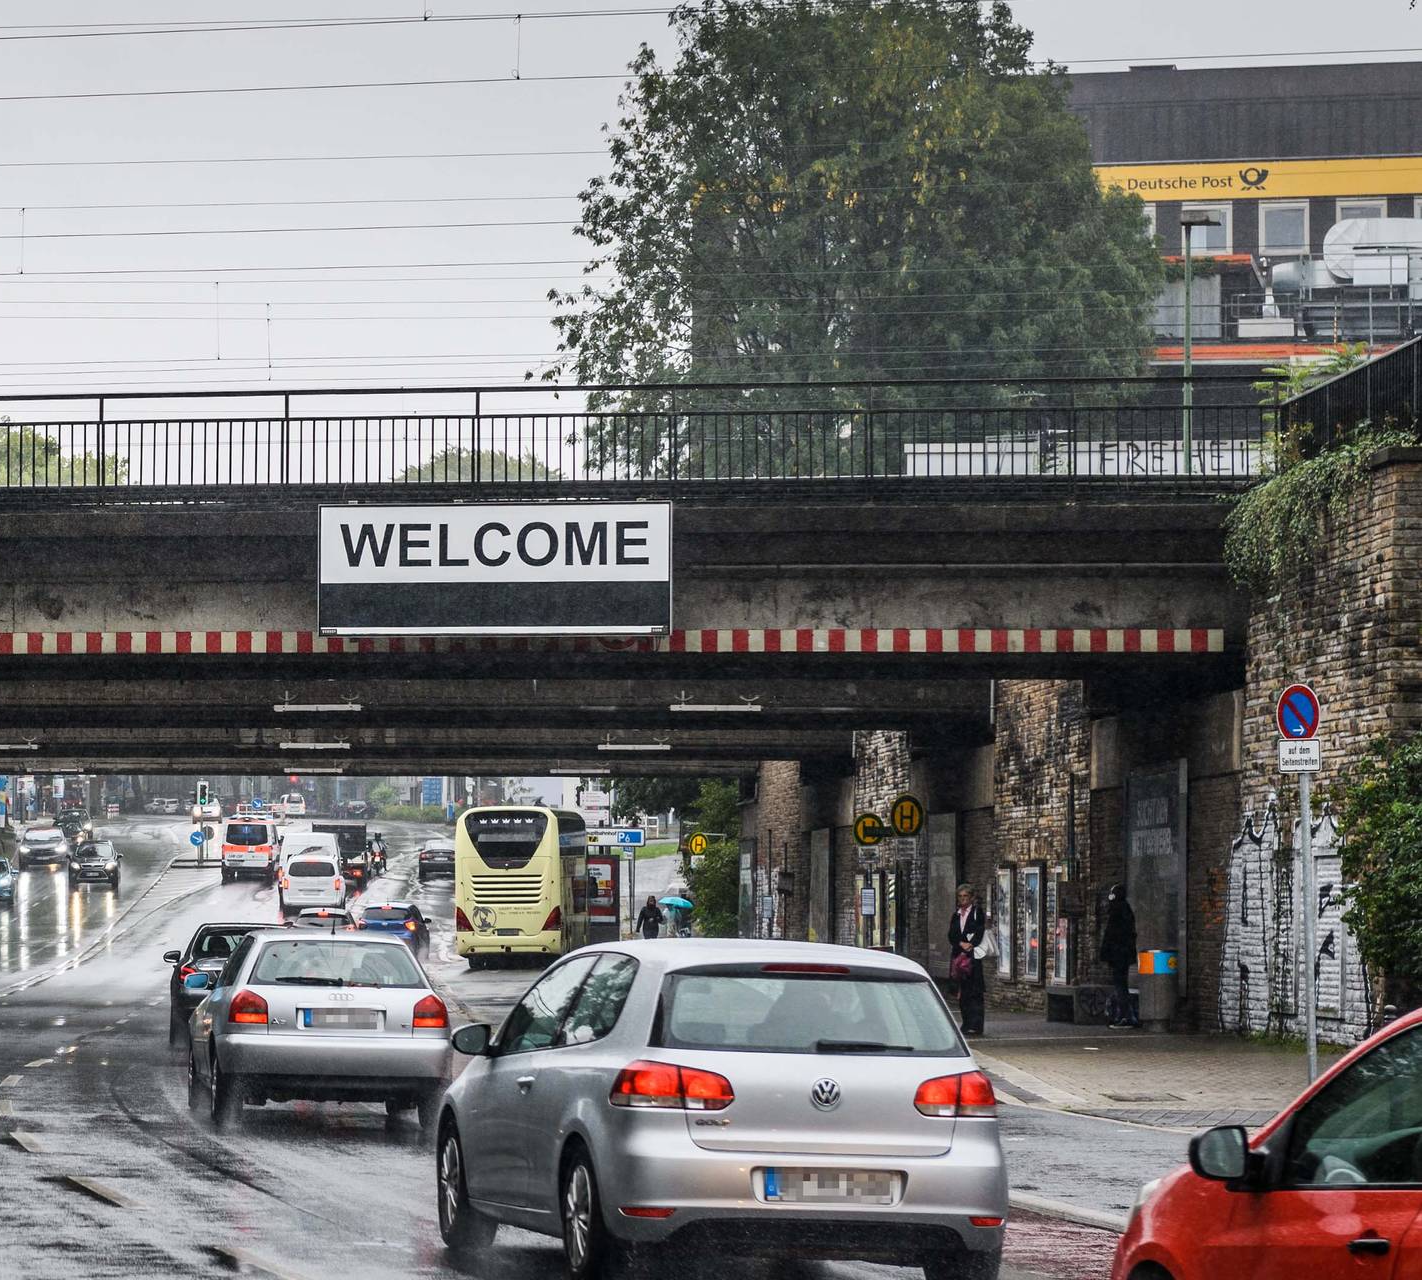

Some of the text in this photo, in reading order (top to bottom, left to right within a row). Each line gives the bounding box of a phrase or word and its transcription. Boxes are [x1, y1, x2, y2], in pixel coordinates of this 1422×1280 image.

[1127, 176, 1233, 191] Deutsche Post
[339, 521, 650, 568] WELCOME
[1288, 745, 1310, 755] auf dem
[1281, 757, 1318, 766] Seitenstreifen
